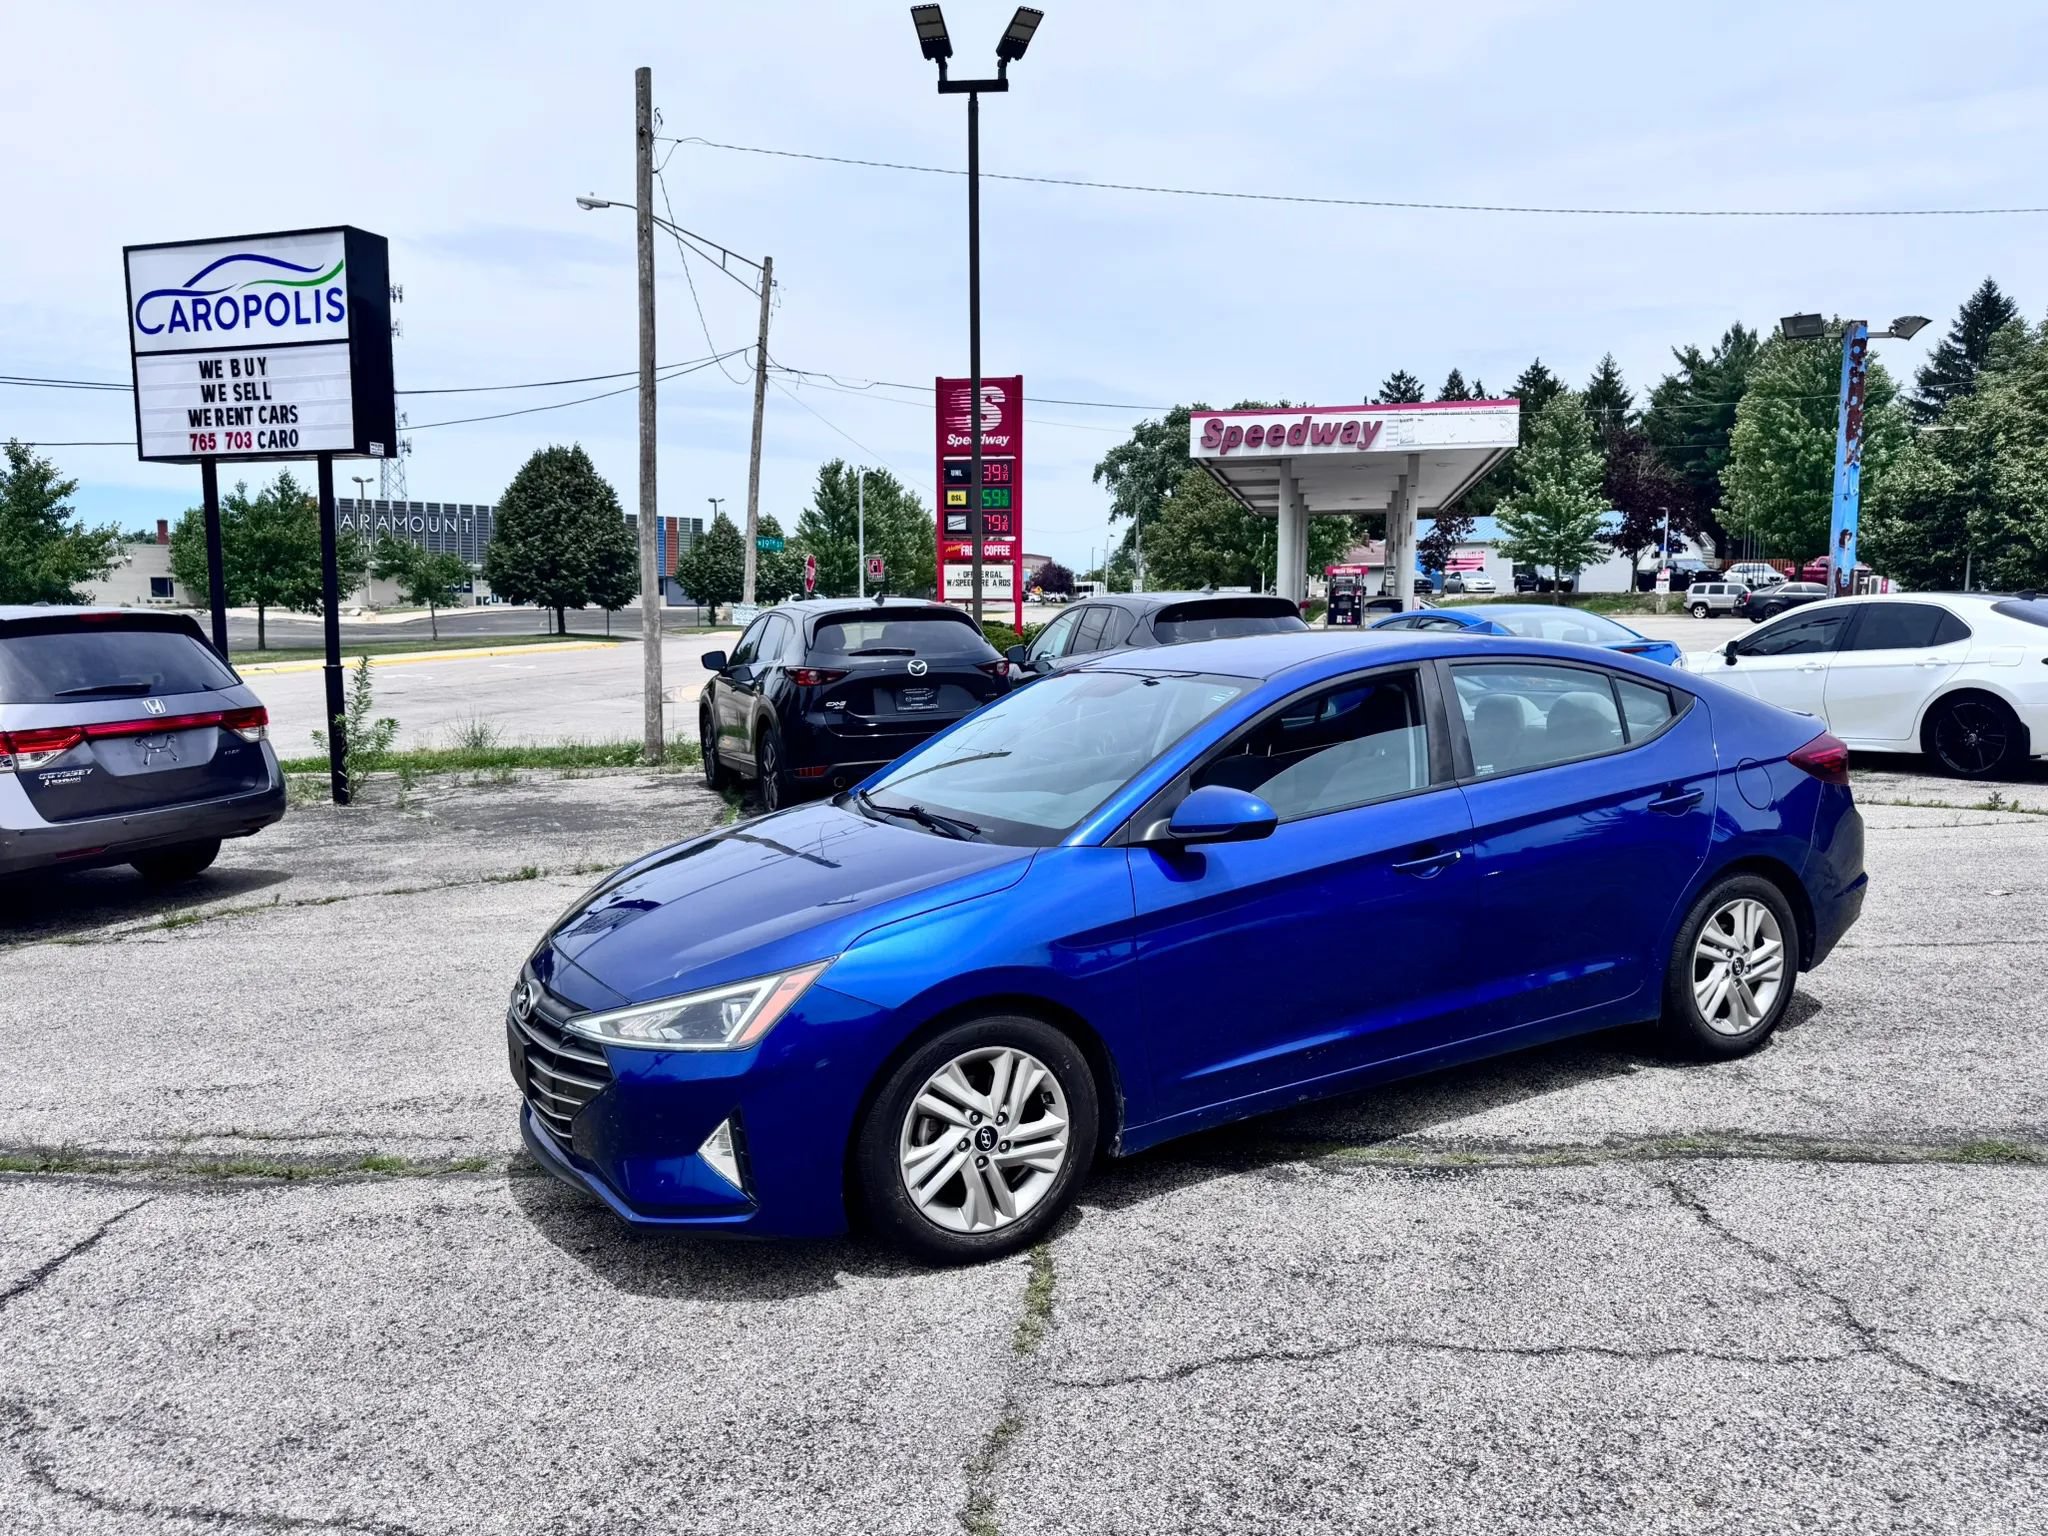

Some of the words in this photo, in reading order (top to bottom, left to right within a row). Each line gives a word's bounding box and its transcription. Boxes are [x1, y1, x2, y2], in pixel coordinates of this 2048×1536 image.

[136, 285, 345, 334] CAROPOLIS
[199, 360, 223, 379] WE
[230, 356, 267, 377] BUY
[201, 384, 227, 403] WE
[233, 381, 272, 401] SELL
[188, 409, 212, 427] WE
[214, 406, 254, 426] RENT
[258, 404, 299, 424] CARS
[189, 432, 217, 452] 765
[225, 430, 253, 450] 703
[257, 428, 299, 449] CARO
[946, 433, 1010, 447] Spedway
[1200, 415, 1383, 455] Speedway
[950, 469, 963, 477] UNL
[951, 494, 963, 502] DSL
[340, 513, 472, 534] ARAMOUNT
[961, 545, 973, 556] FRE
[984, 545, 1010, 556] COFFEE
[38, 768, 94, 780] ODYSSEY
